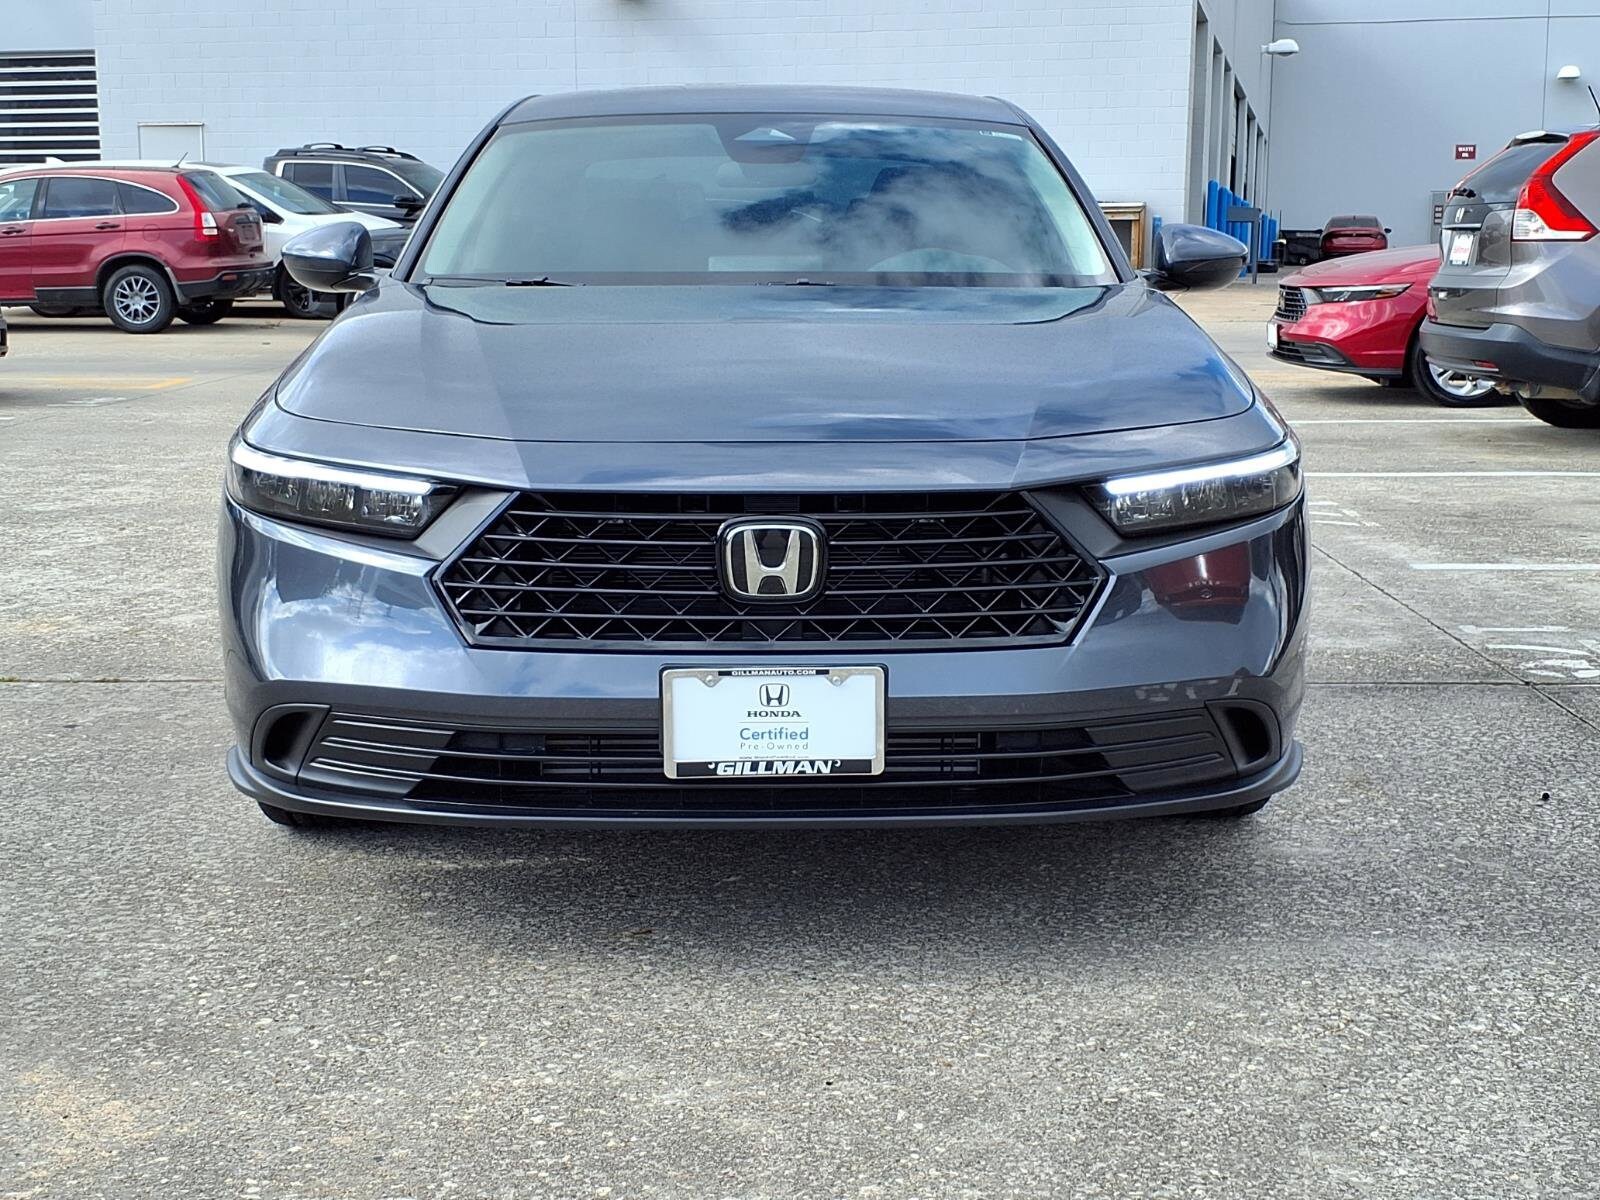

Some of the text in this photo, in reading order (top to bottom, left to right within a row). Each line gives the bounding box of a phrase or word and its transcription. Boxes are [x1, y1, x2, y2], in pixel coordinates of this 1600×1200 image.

[732, 669, 817, 677] GILLMANAUTO.COM
[747, 709, 802, 718] HONDA
[740, 727, 809, 740] Certified
[740, 742, 808, 751] Pre-Owned
[716, 760, 833, 776] GILLMAN
